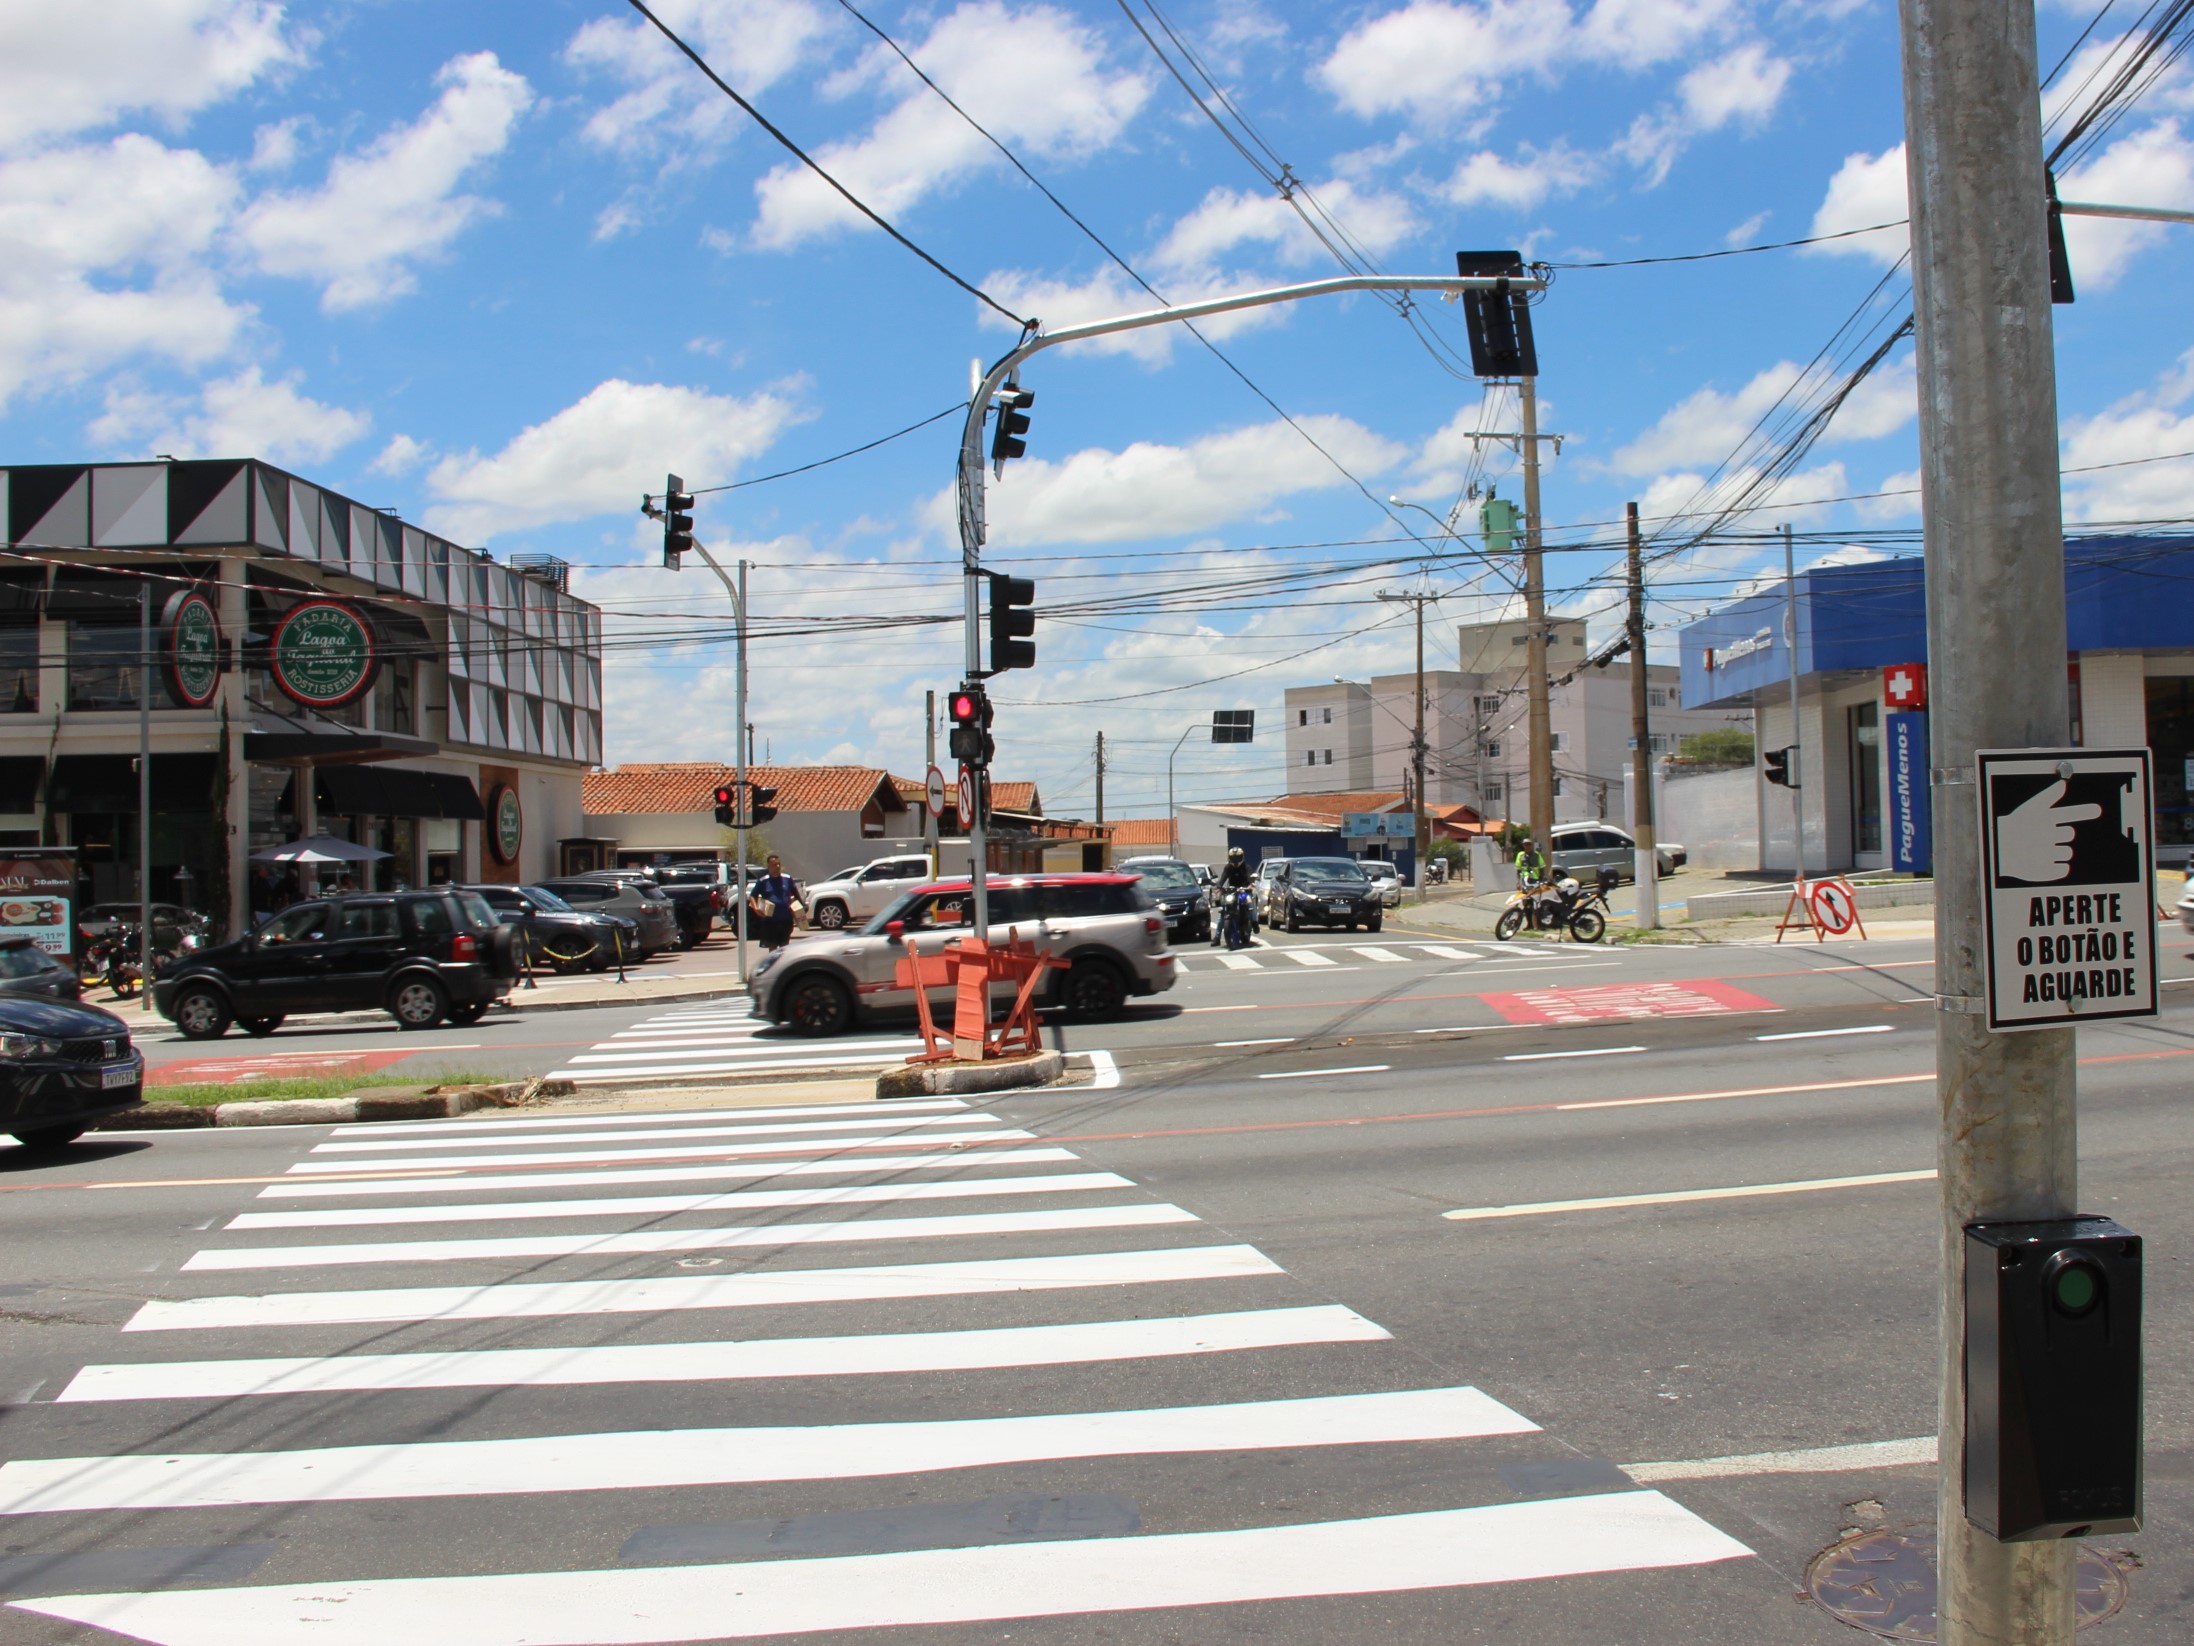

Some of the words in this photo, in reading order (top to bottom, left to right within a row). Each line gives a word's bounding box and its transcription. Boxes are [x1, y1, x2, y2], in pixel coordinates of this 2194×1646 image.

[292, 611, 353, 633] PADARIA
[298, 630, 347, 648] Lagoa
[287, 668, 358, 694] ROSTISSERIA
[1897, 722, 1915, 863] PagueMenos
[2029, 892, 2122, 927] APERTE
[2017, 936, 2033, 967] O
[2038, 927, 2118, 965] BOTÃO
[2123, 931, 2135, 960] E
[2022, 967, 2136, 1003] AGUARDE
